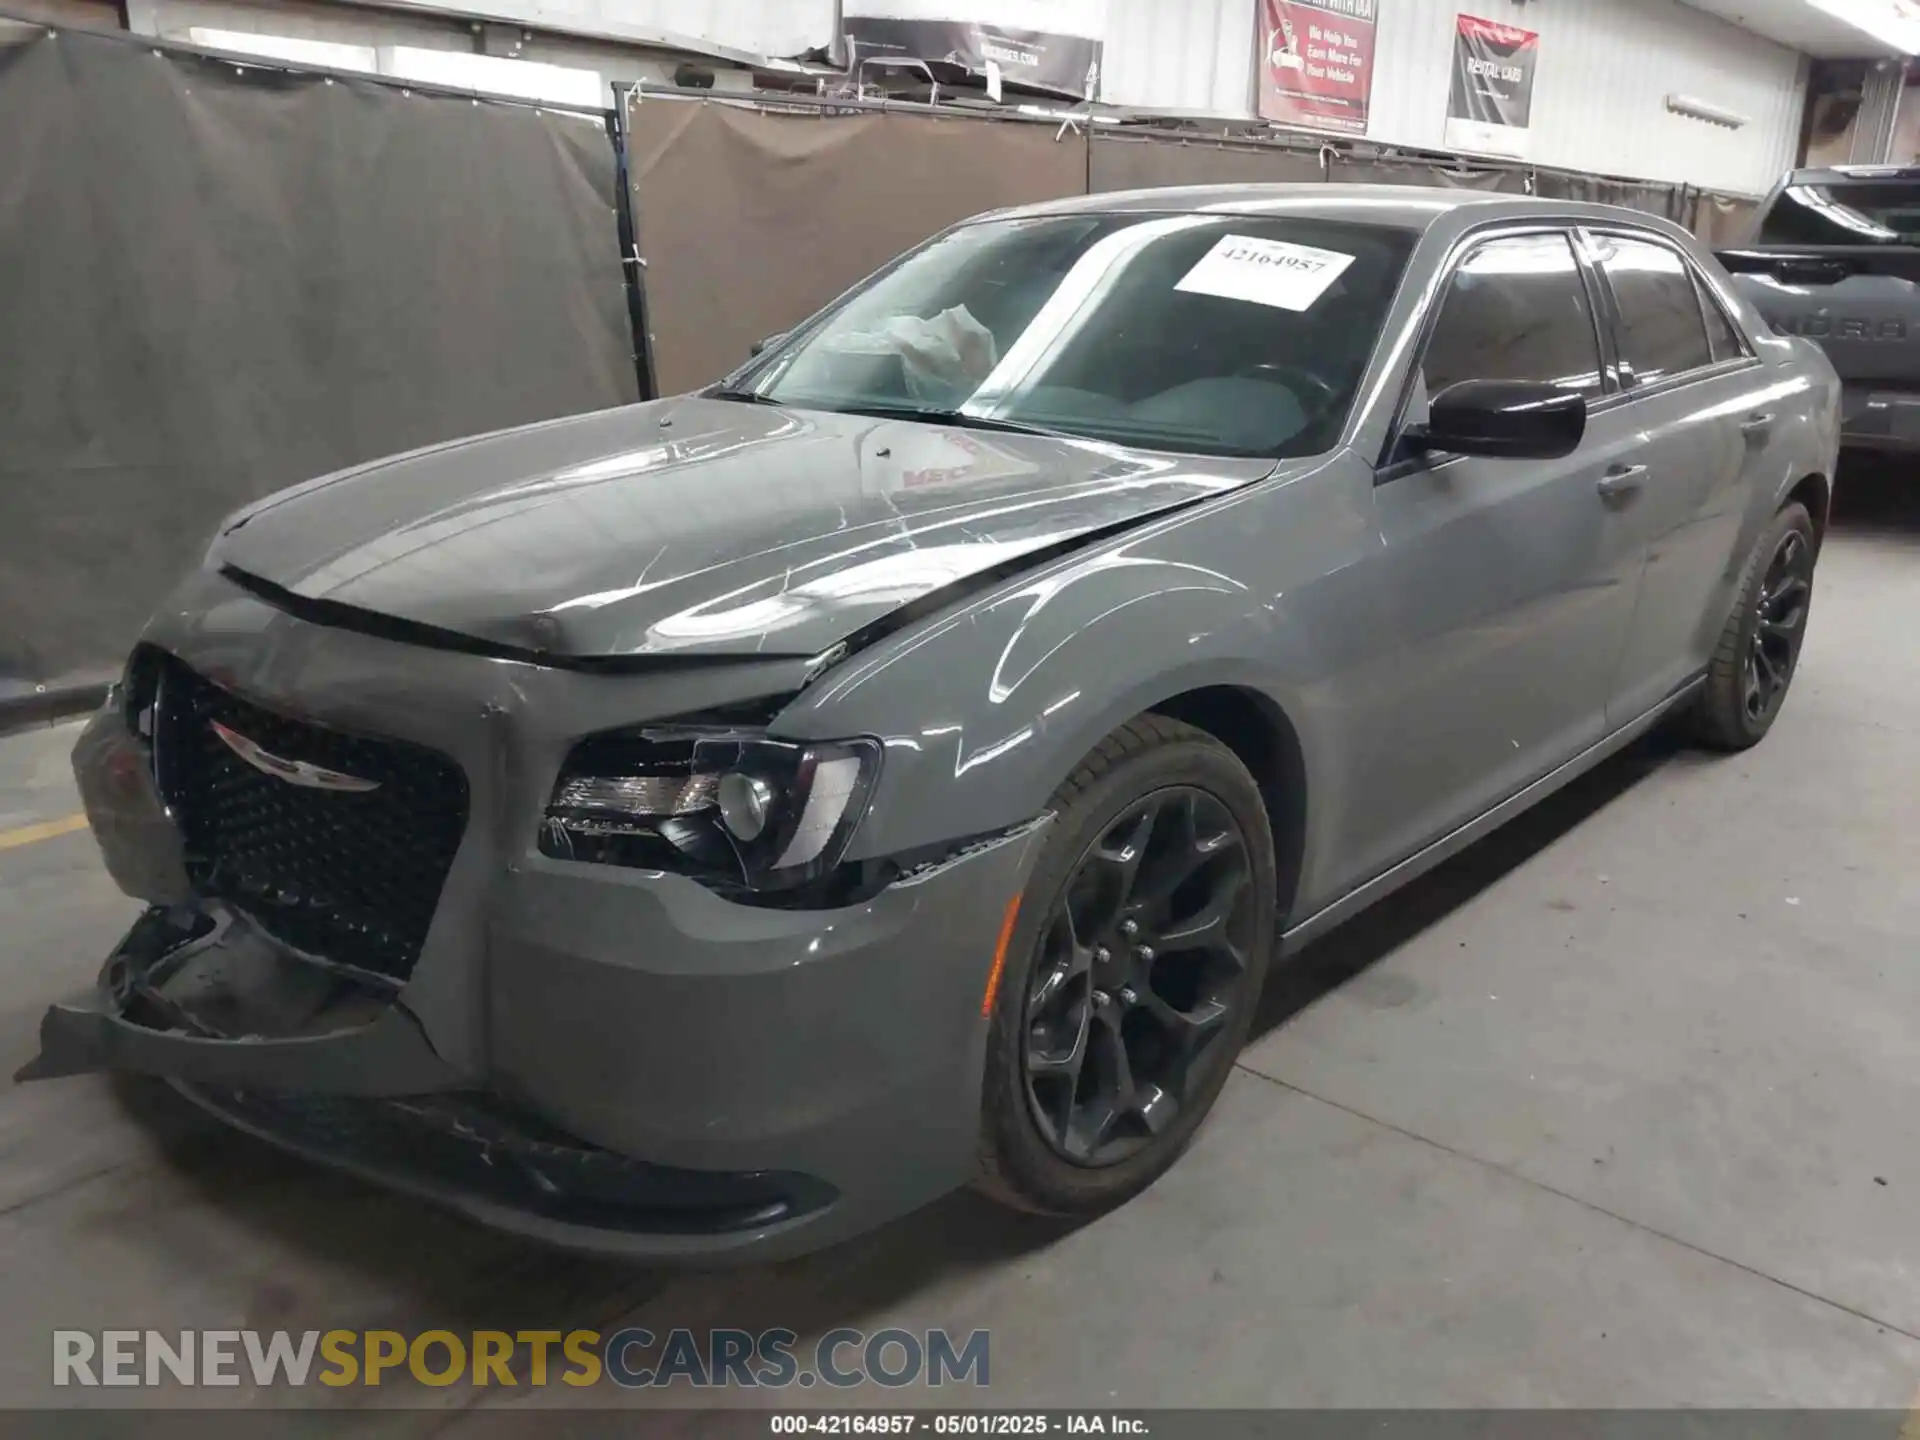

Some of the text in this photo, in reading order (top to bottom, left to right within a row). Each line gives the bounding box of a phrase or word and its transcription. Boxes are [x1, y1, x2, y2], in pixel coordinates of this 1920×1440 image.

[1323, 28, 1342, 46] Help
[1343, 33, 1358, 48] You
[1307, 44, 1362, 67] Earn More For
[1307, 63, 1355, 83] Your Vehicle
[1467, 57, 1499, 78] RENTAL
[1220, 248, 1328, 273] 42164957
